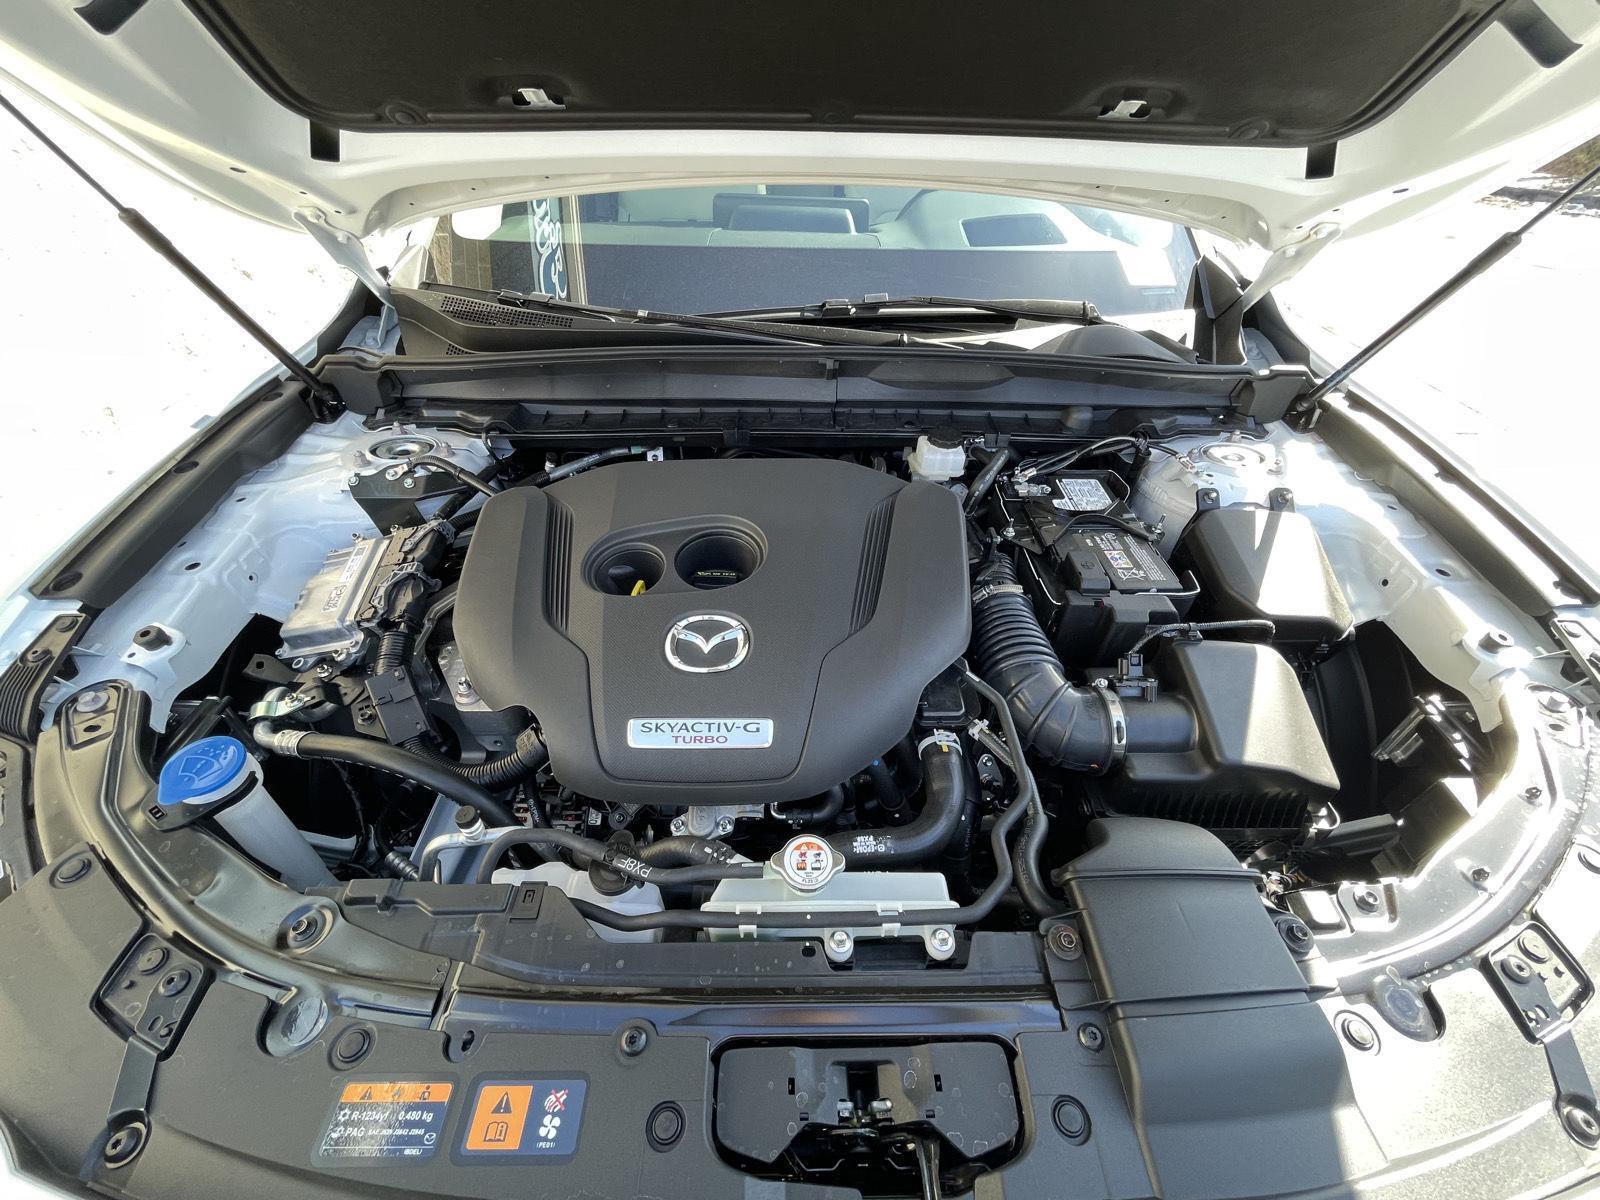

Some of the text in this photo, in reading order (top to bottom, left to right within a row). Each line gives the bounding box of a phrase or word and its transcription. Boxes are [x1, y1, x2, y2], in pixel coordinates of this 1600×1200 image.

[640, 721, 761, 734] SKYACTIV-G
[672, 734, 728, 745] TURBO
[617, 857, 653, 878] PX8F
[350, 1110, 389, 1123] R-1234yf
[421, 1110, 434, 1123] kg
[344, 1126, 366, 1138] PAG
